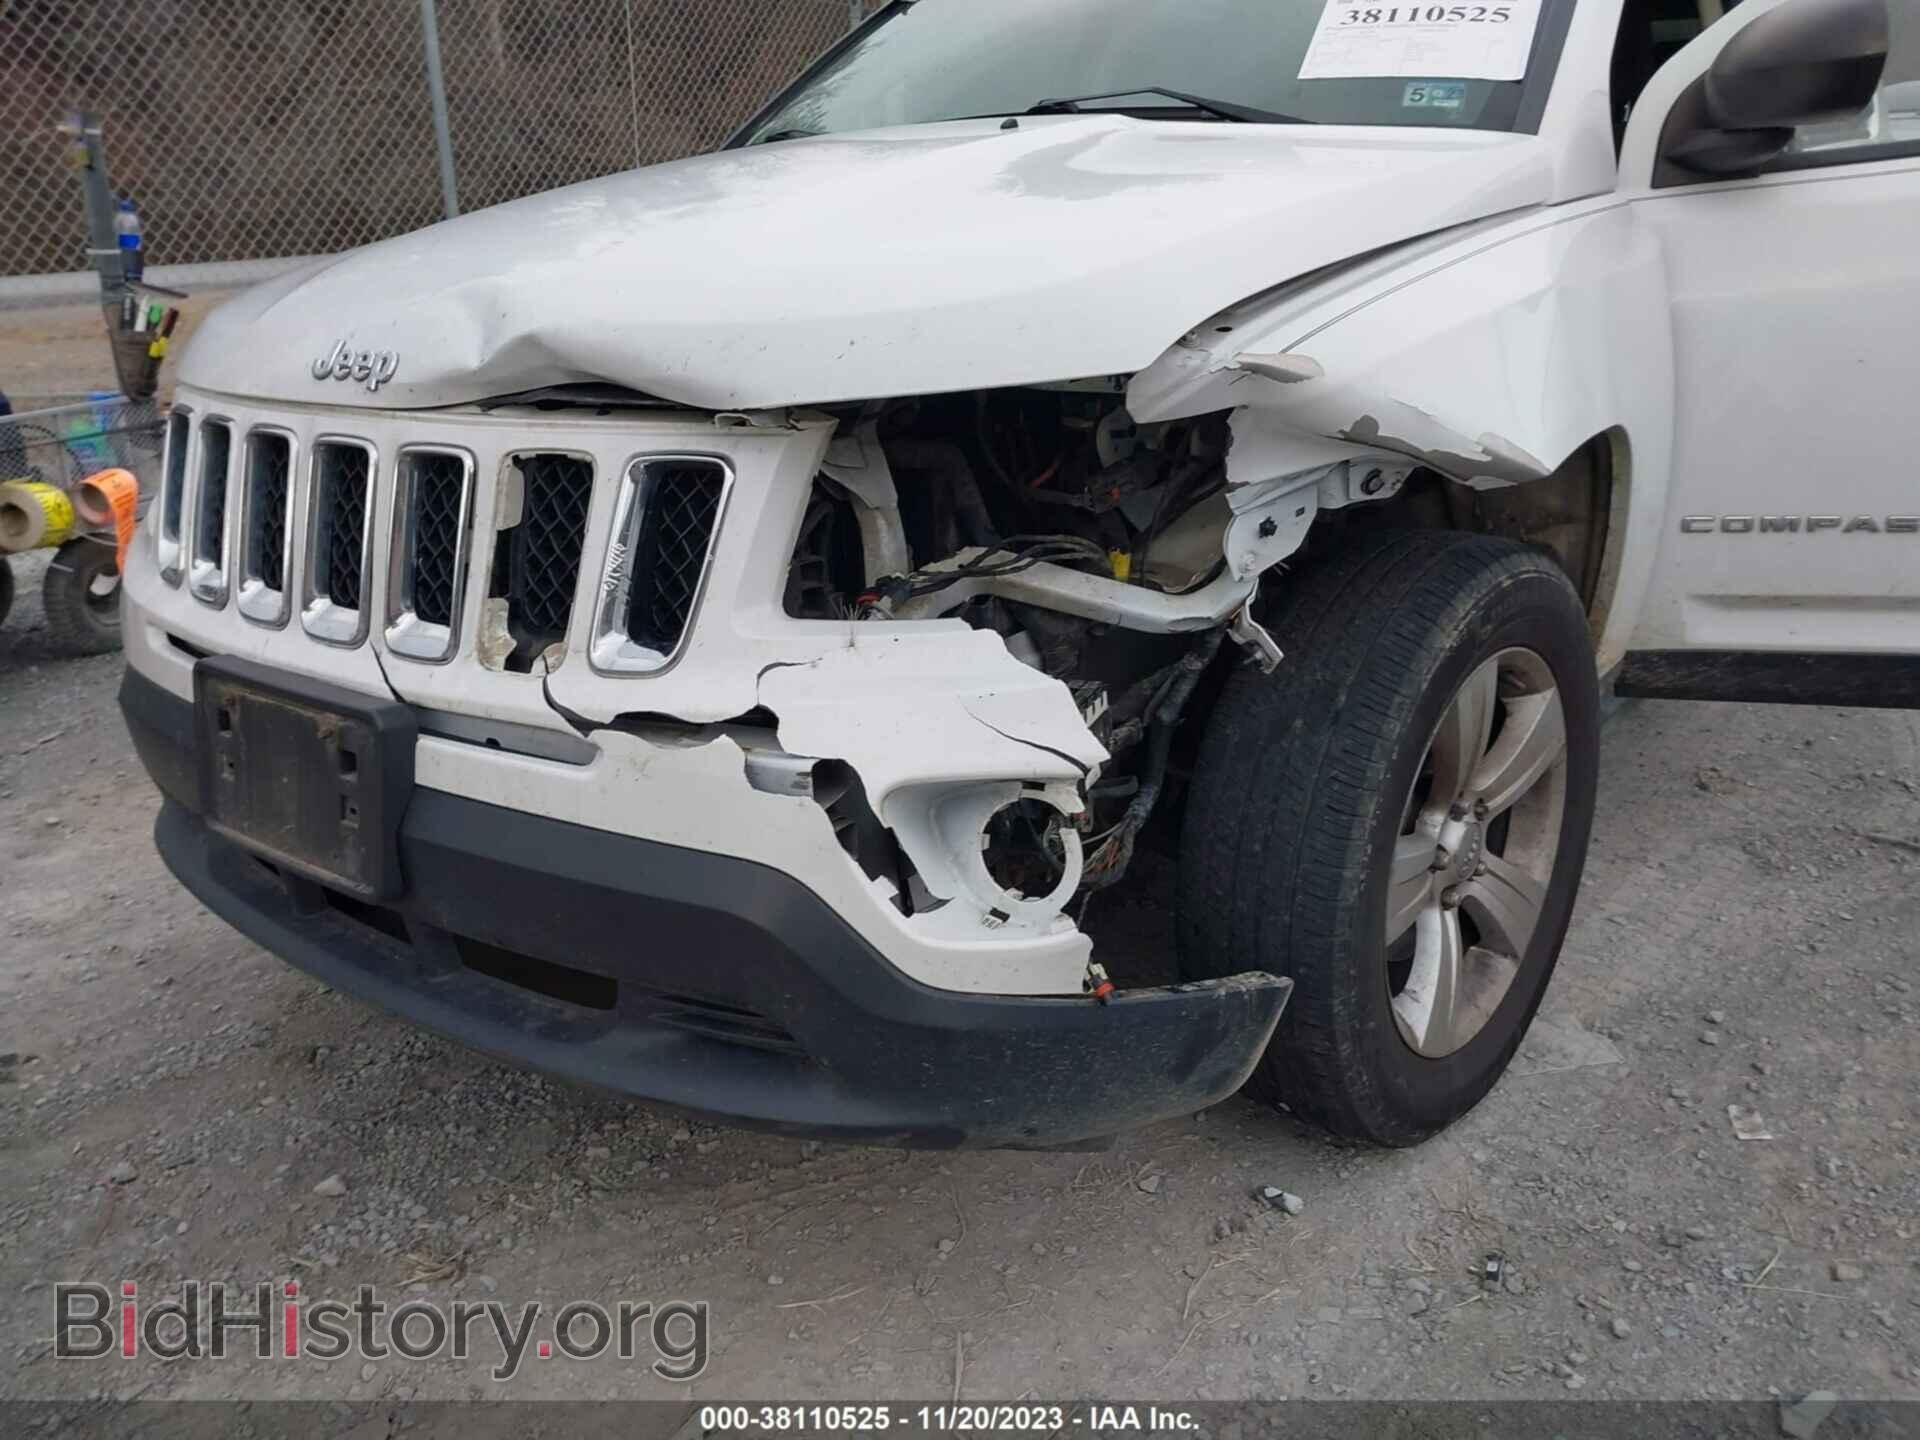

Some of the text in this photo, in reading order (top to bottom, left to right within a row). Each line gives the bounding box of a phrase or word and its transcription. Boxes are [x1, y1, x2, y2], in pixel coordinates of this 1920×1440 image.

[1339, 5, 1512, 25] 38110525
[1409, 87, 1426, 103] 5
[311, 338, 400, 392] Jeep
[1680, 515, 1920, 534] COMPAS
